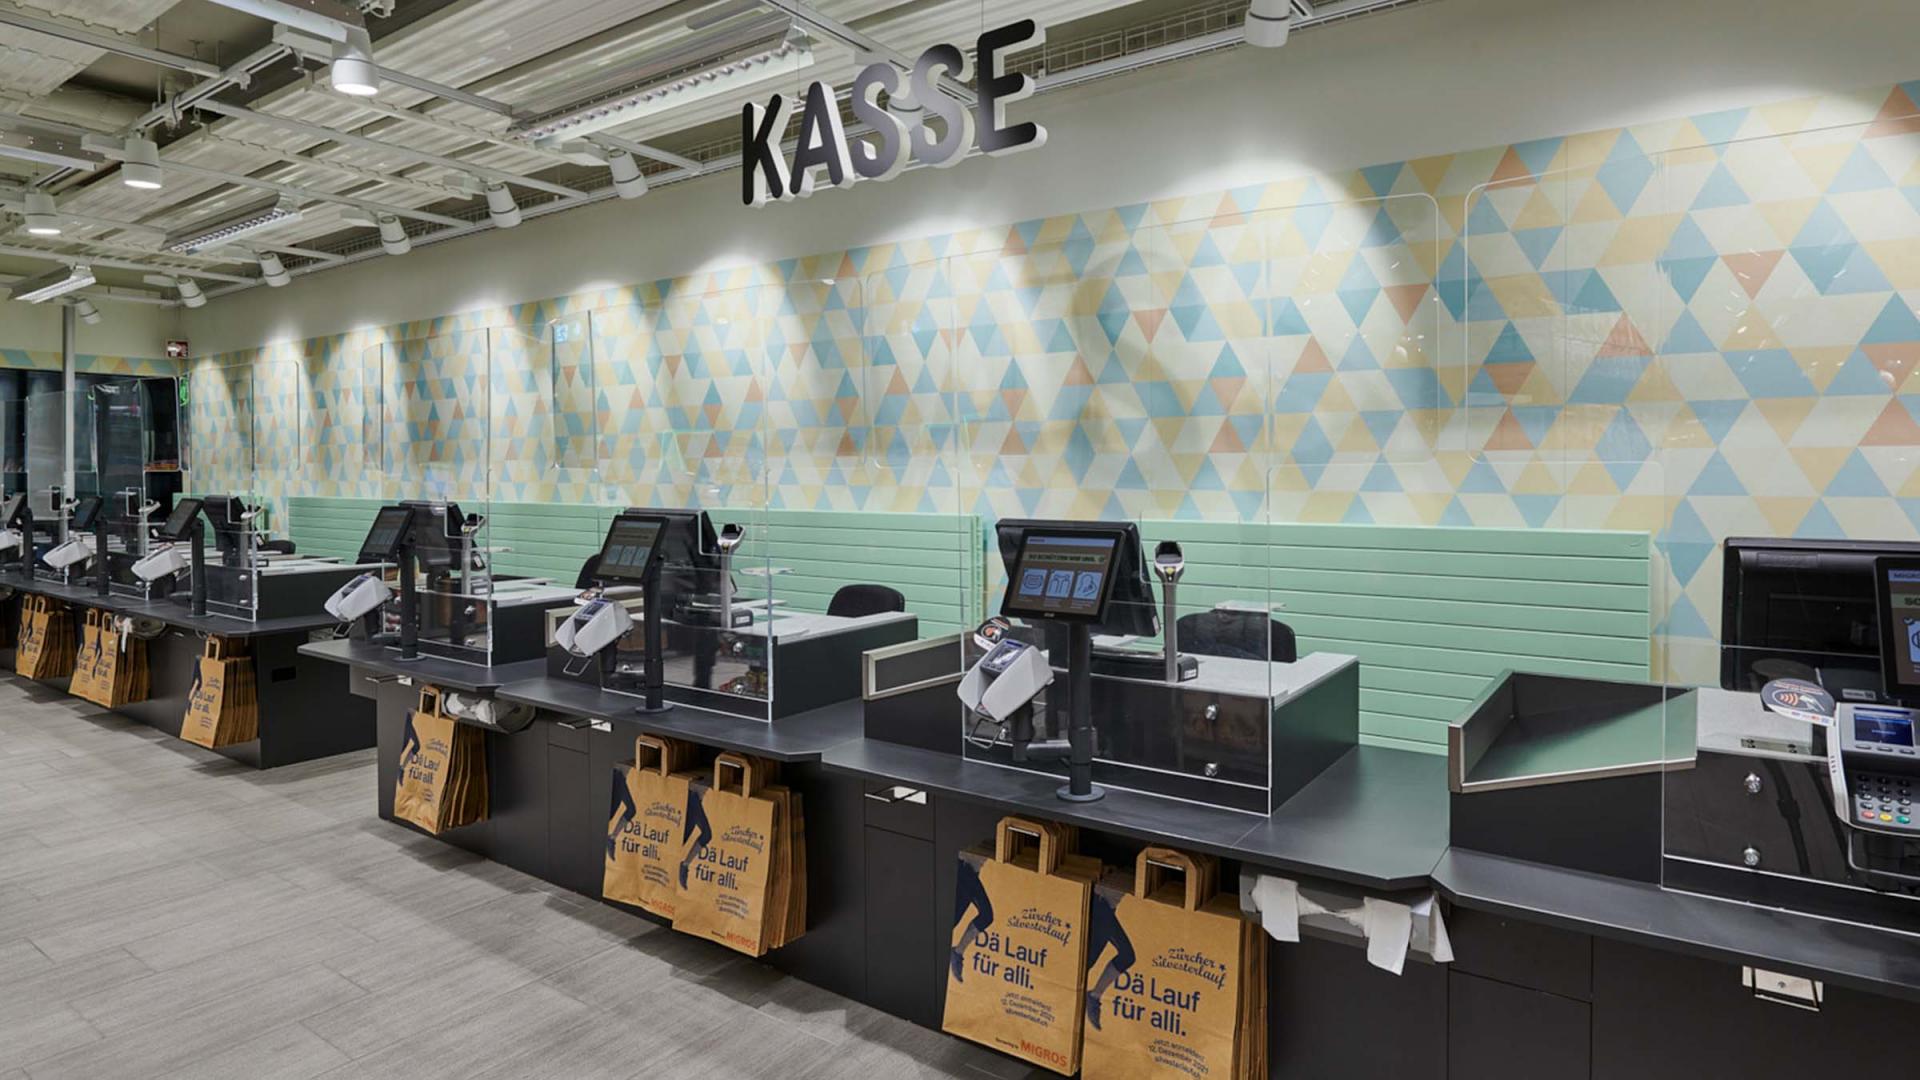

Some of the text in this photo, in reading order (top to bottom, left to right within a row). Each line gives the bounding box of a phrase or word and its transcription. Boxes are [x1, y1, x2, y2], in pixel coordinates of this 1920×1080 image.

[742, 19, 1047, 207] KASSE
[623, 820, 669, 844] Dä Lauf
[621, 837, 660, 861] für alli.
[698, 846, 749, 872] Dä Lauf
[695, 863, 738, 891] für alli.
[1007, 916, 1071, 947] Silvesterlauf
[1021, 907, 1062, 927] Zürcher
[975, 930, 1048, 968] Dä Lauf
[1168, 947, 1216, 968] Zürcher
[973, 952, 1034, 990] für alli.
[1152, 955, 1227, 990] Silvesterlauf
[1114, 970, 1200, 1012] Dä Lauf
[1112, 996, 1186, 1036] für alli.
[1020, 1039, 1068, 1067] MIGROS
